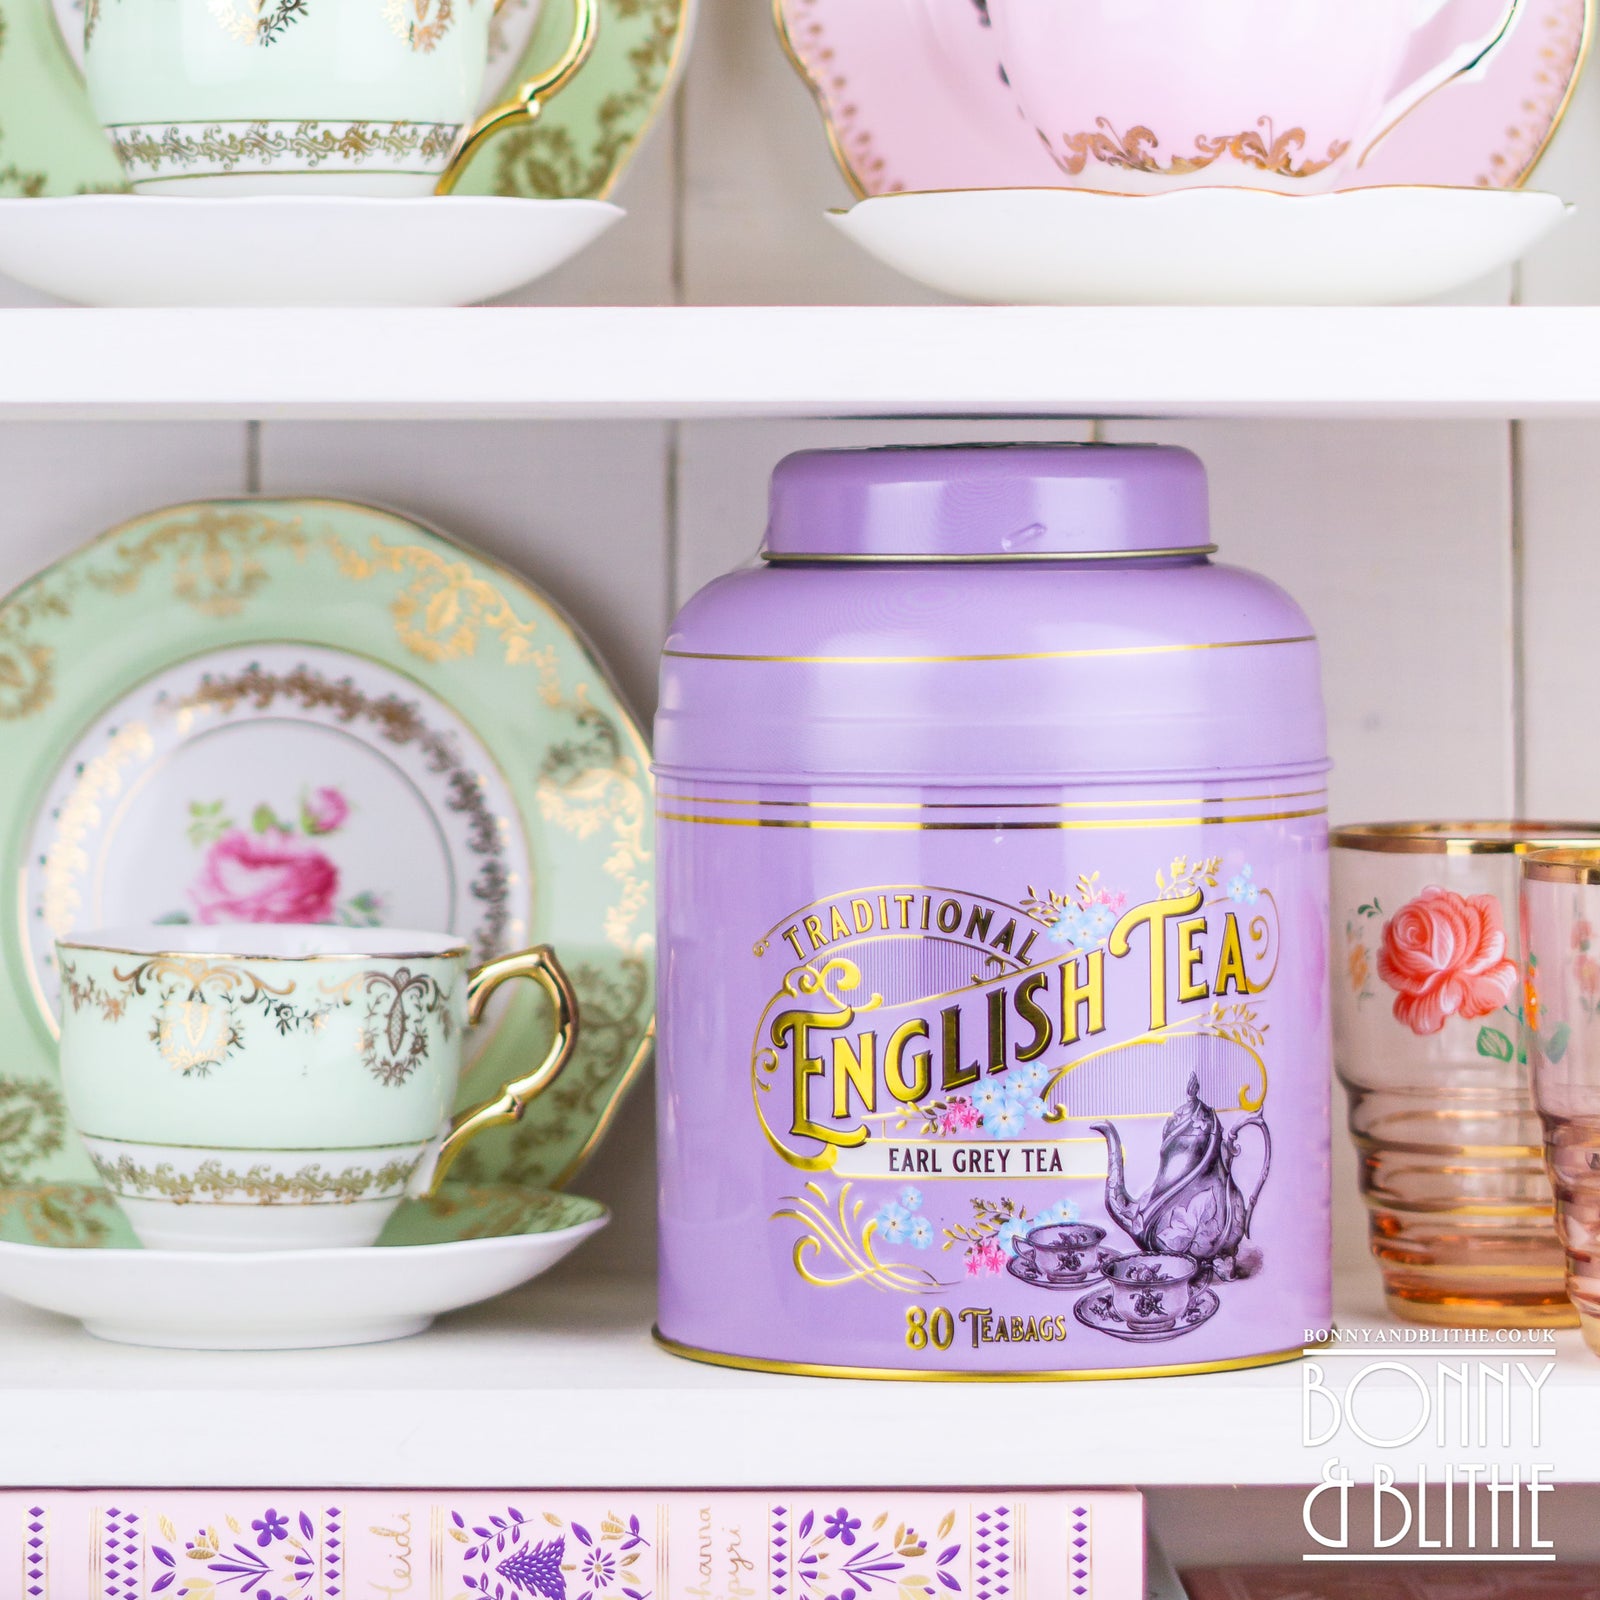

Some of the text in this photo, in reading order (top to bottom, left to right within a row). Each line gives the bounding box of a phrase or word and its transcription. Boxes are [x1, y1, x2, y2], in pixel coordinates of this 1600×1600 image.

[781, 894, 1040, 967] TRADITIONAL
[770, 887, 1250, 1148] ENGLISH TEA
[888, 1148, 1063, 1173] EARL GREY TEA
[905, 1304, 1067, 1351] 80 TEABAGS
[684, 1505, 713, 1600] hanna
[717, 1526, 756, 1600] pyri
